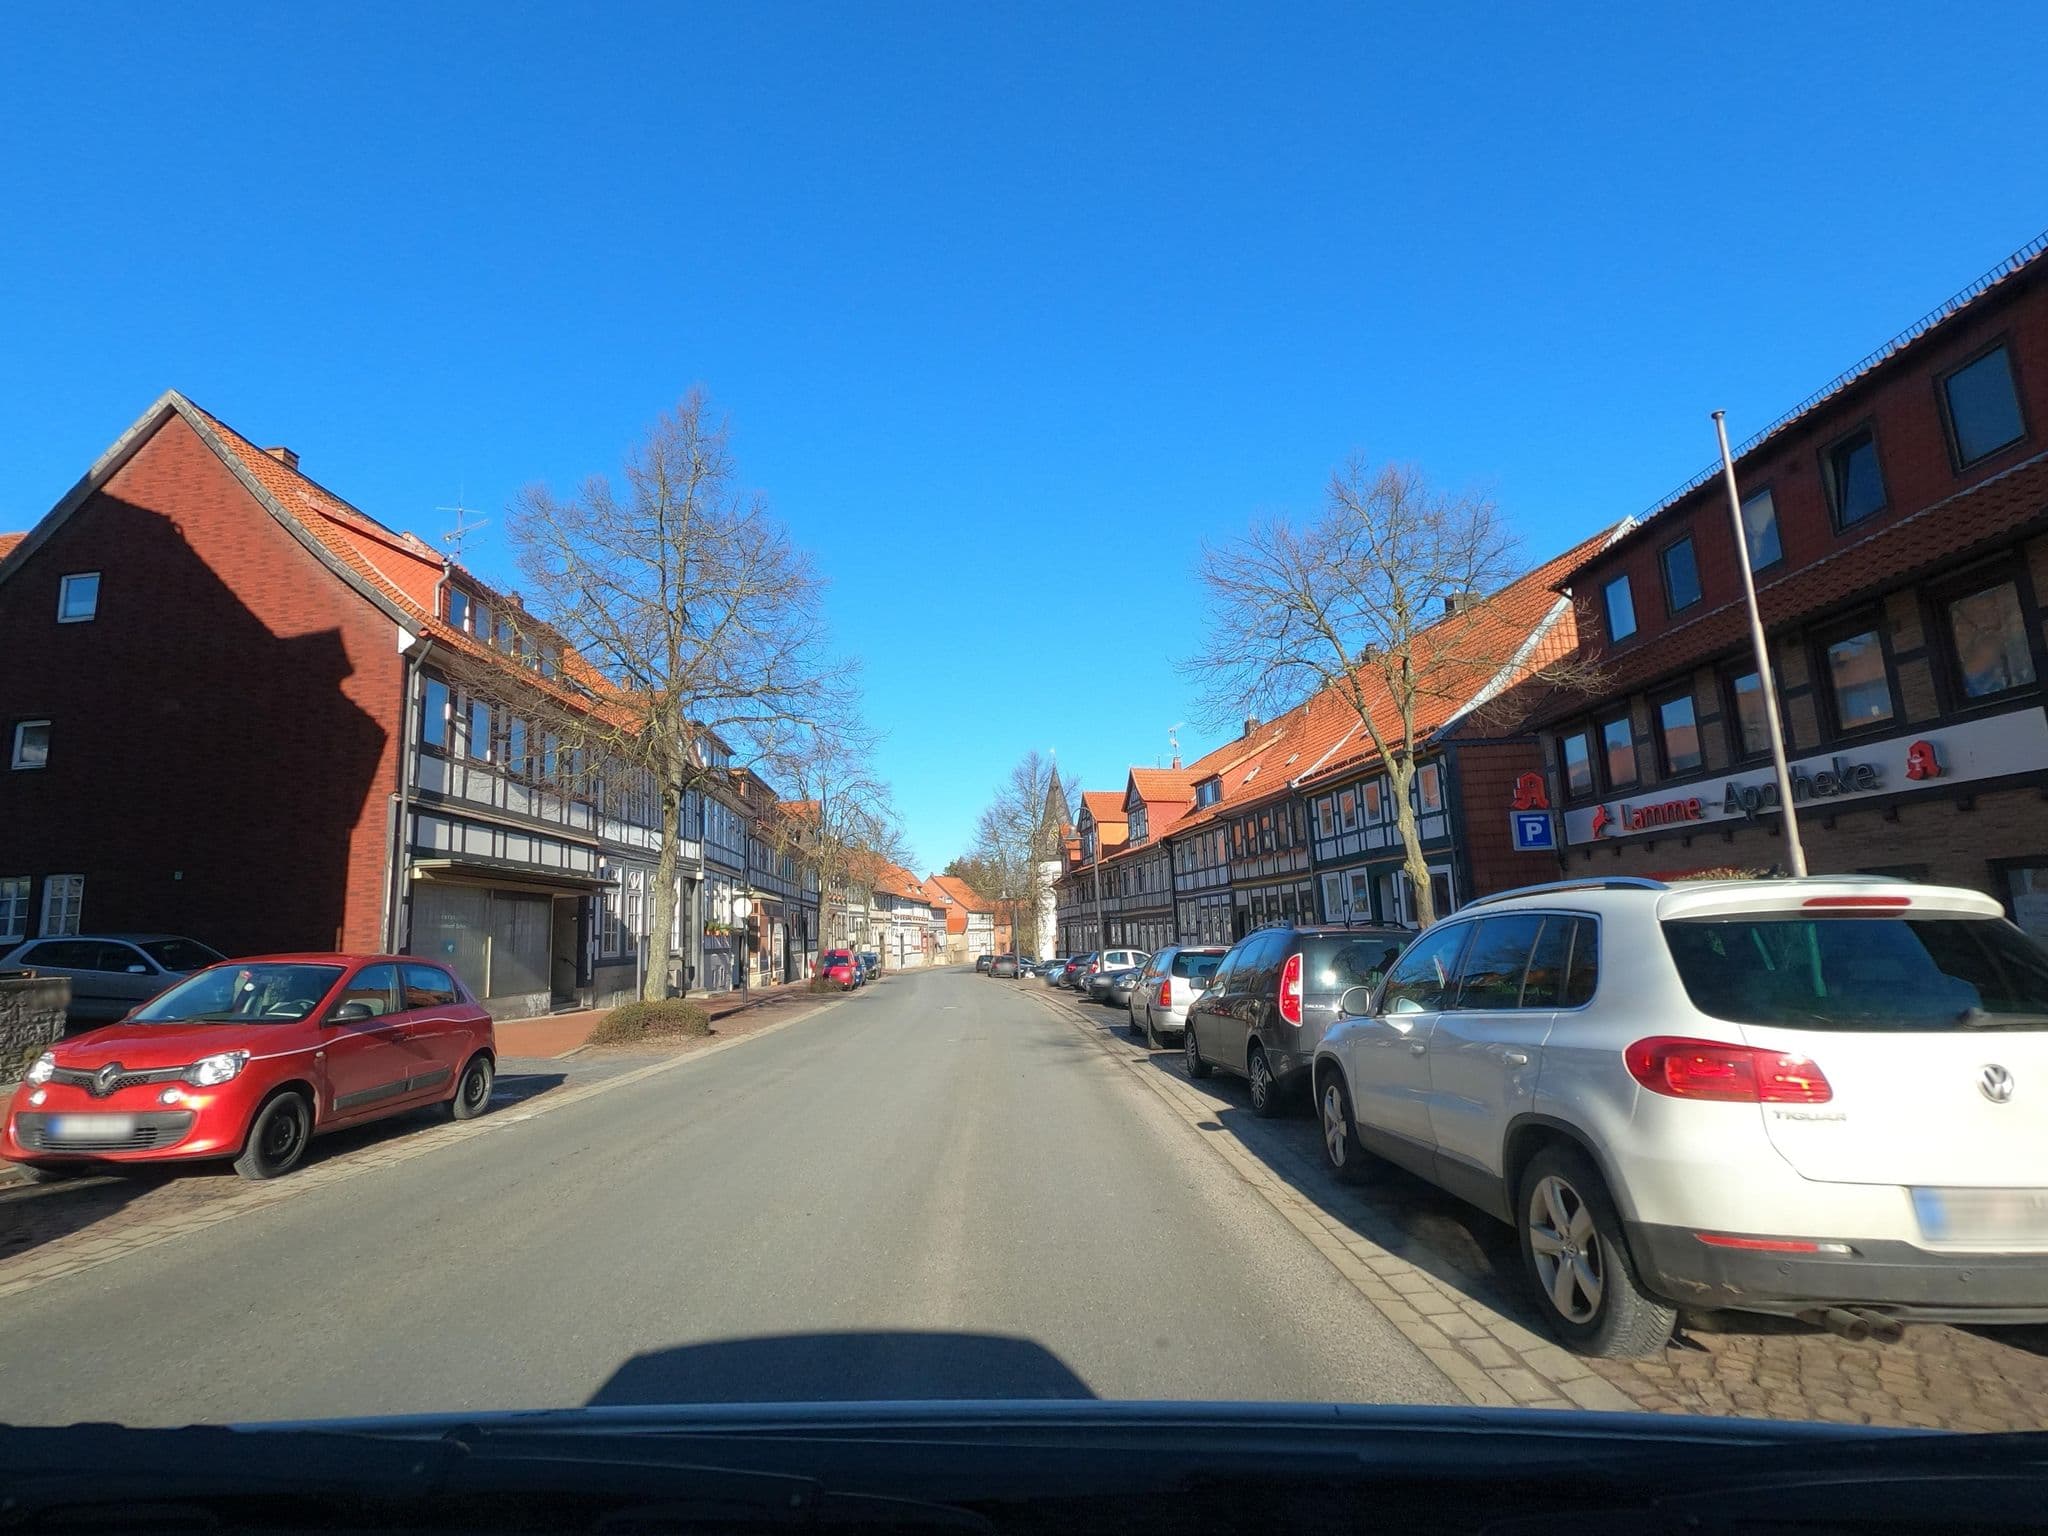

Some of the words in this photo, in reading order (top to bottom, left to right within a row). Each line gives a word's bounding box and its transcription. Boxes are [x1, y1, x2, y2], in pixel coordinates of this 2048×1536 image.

[1620, 797, 1702, 832] Lamme
[1724, 756, 1878, 821] Apoheke
[1526, 822, 1543, 841] P
